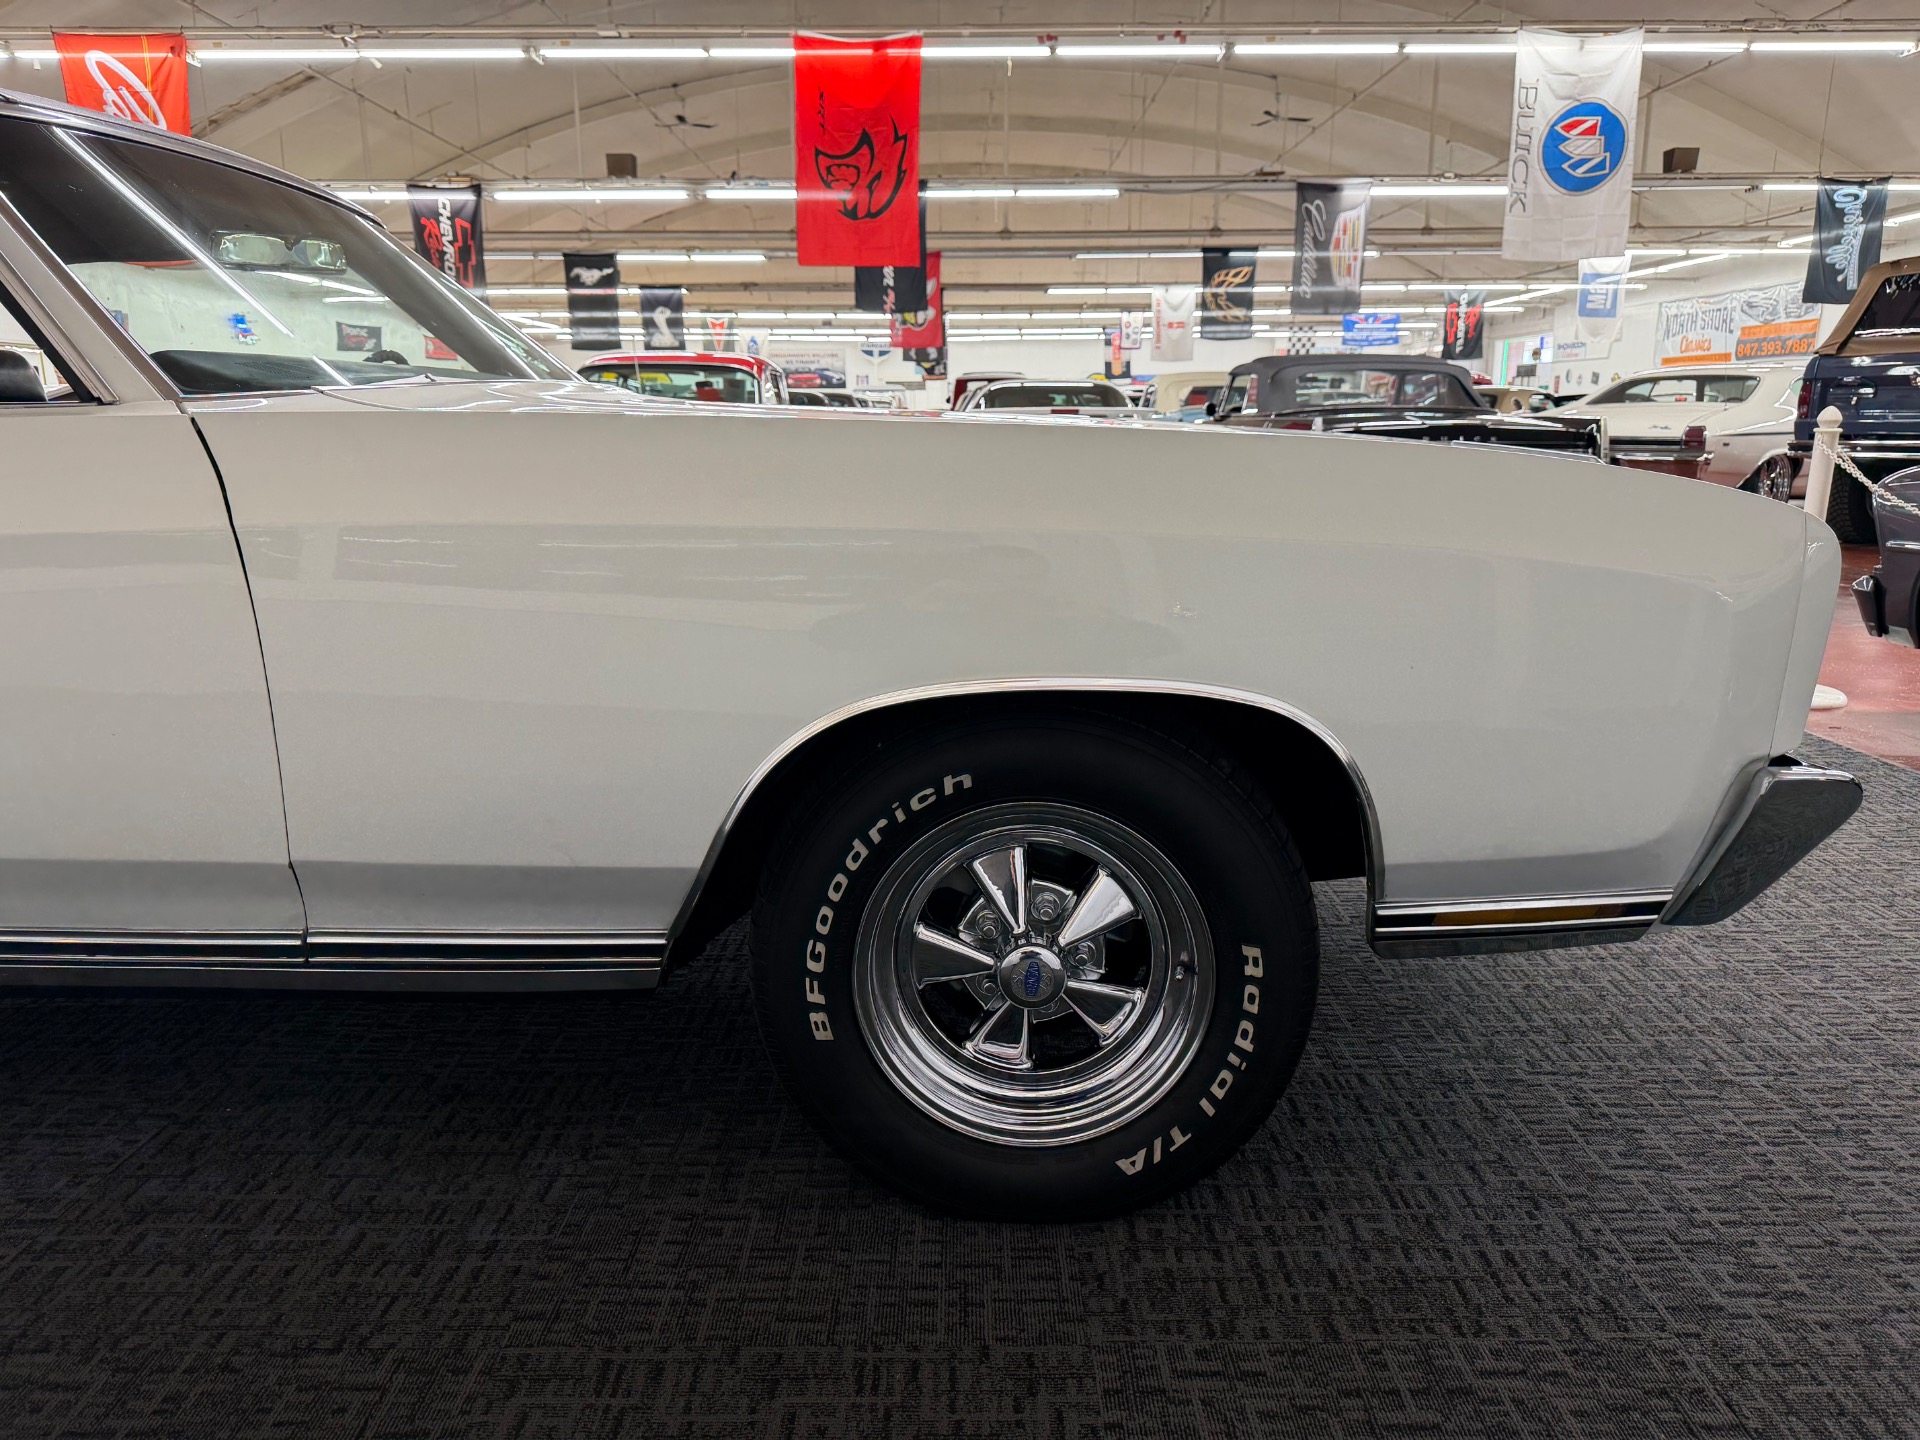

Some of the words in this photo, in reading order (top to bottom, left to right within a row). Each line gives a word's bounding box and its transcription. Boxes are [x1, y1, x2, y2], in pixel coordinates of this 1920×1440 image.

[1509, 78, 1540, 213] BUICK
[438, 196, 457, 280] CHEVRO
[1300, 199, 1326, 299] Cadillac
[1663, 307, 1698, 341] NORTH
[1700, 306, 1737, 334] SHORE
[1737, 338, 1815, 357] 847.393.7887
[806, 773, 973, 1041] BFGoodrich
[1199, 944, 1264, 1118] Radial
[1115, 1126, 1192, 1176] T/A
